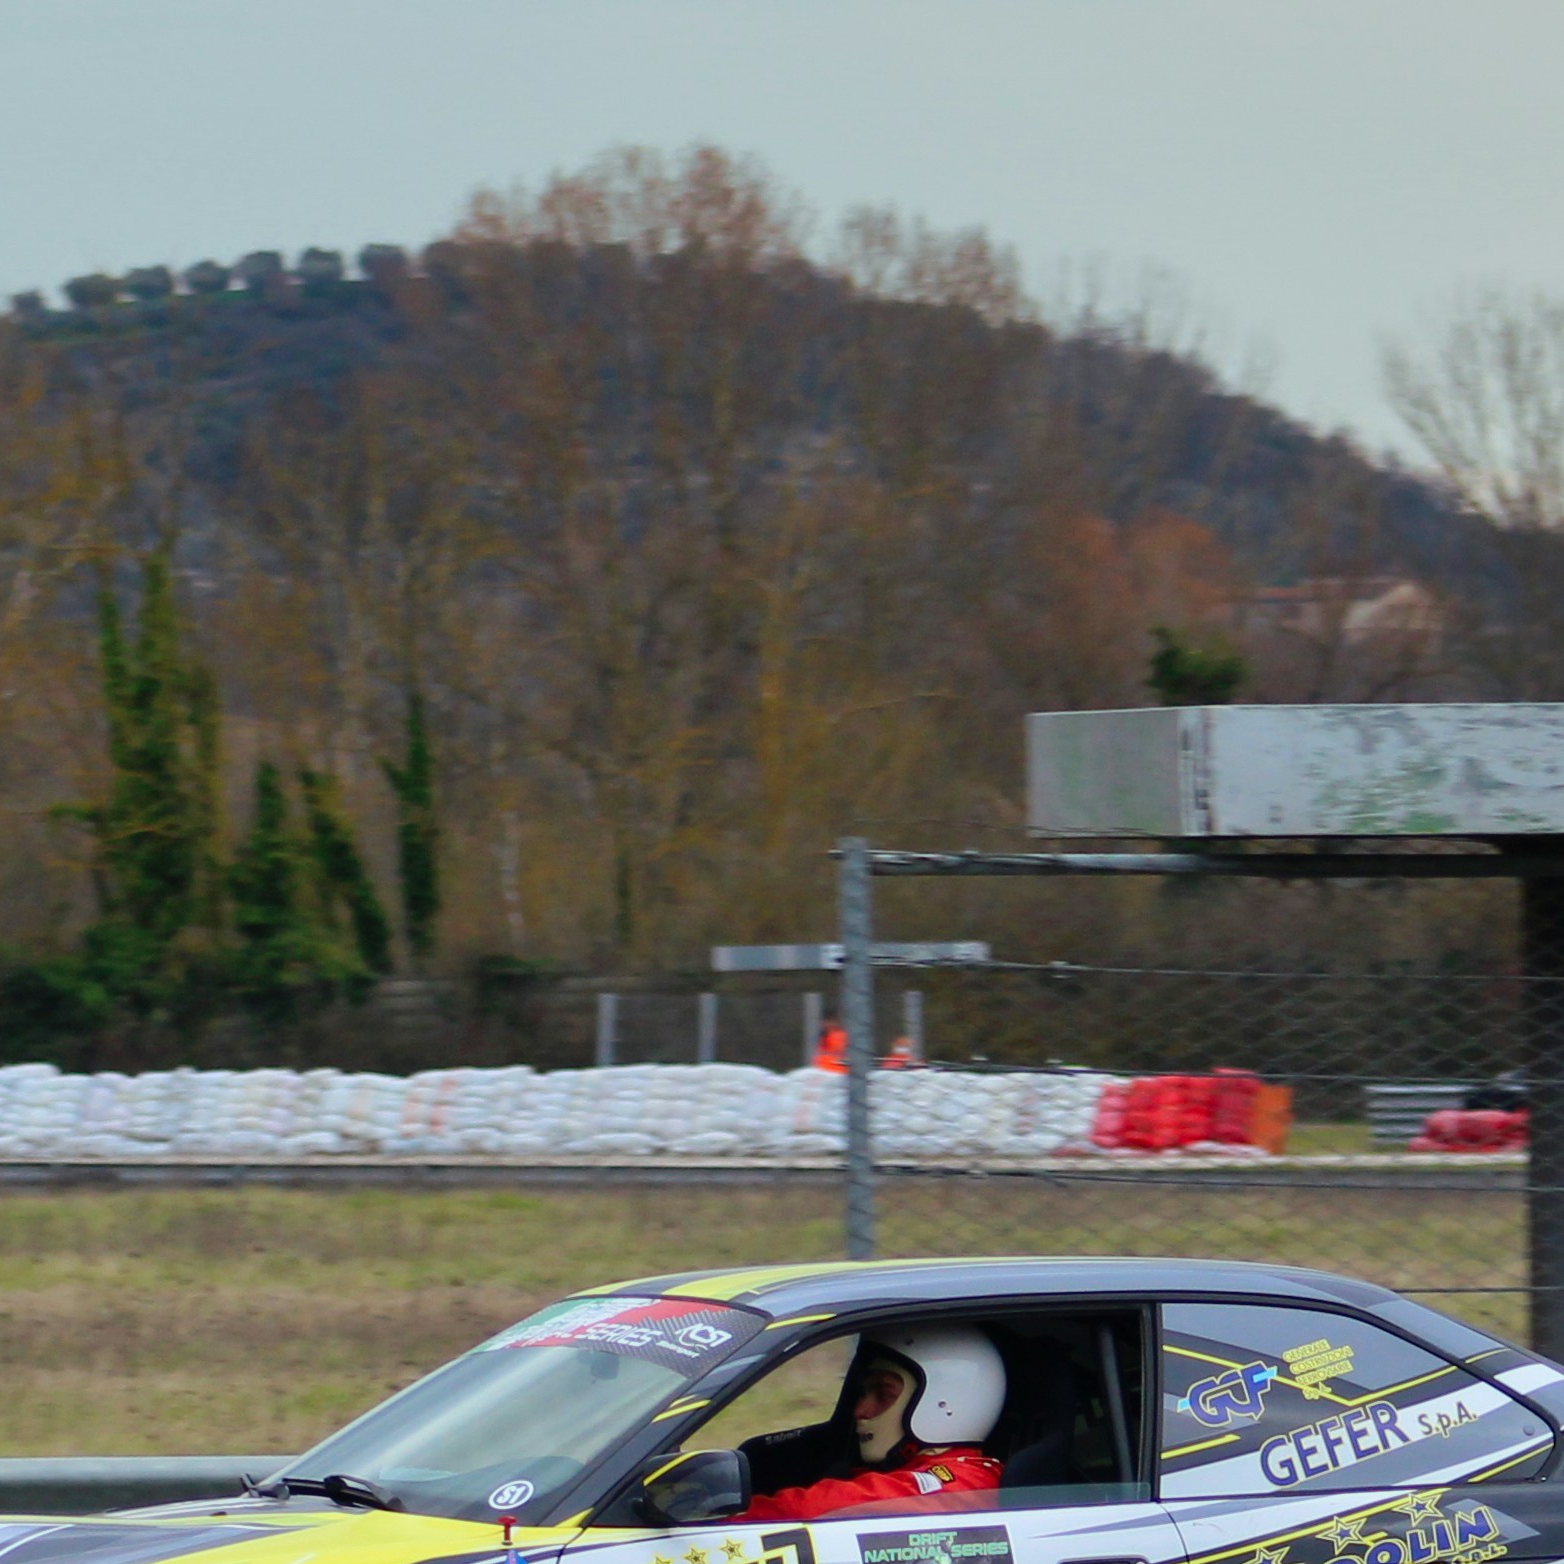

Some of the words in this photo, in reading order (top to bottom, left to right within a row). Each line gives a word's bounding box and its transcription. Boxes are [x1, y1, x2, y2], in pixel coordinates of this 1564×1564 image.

[574, 1322, 662, 1347] SERIES
[1261, 1402, 1411, 1486] GEFER
[496, 1485, 527, 1504] S1
[909, 1532, 957, 1546] DRIFT
[865, 1549, 945, 1563] NATIONAL
[952, 1542, 1009, 1557] SERIES
